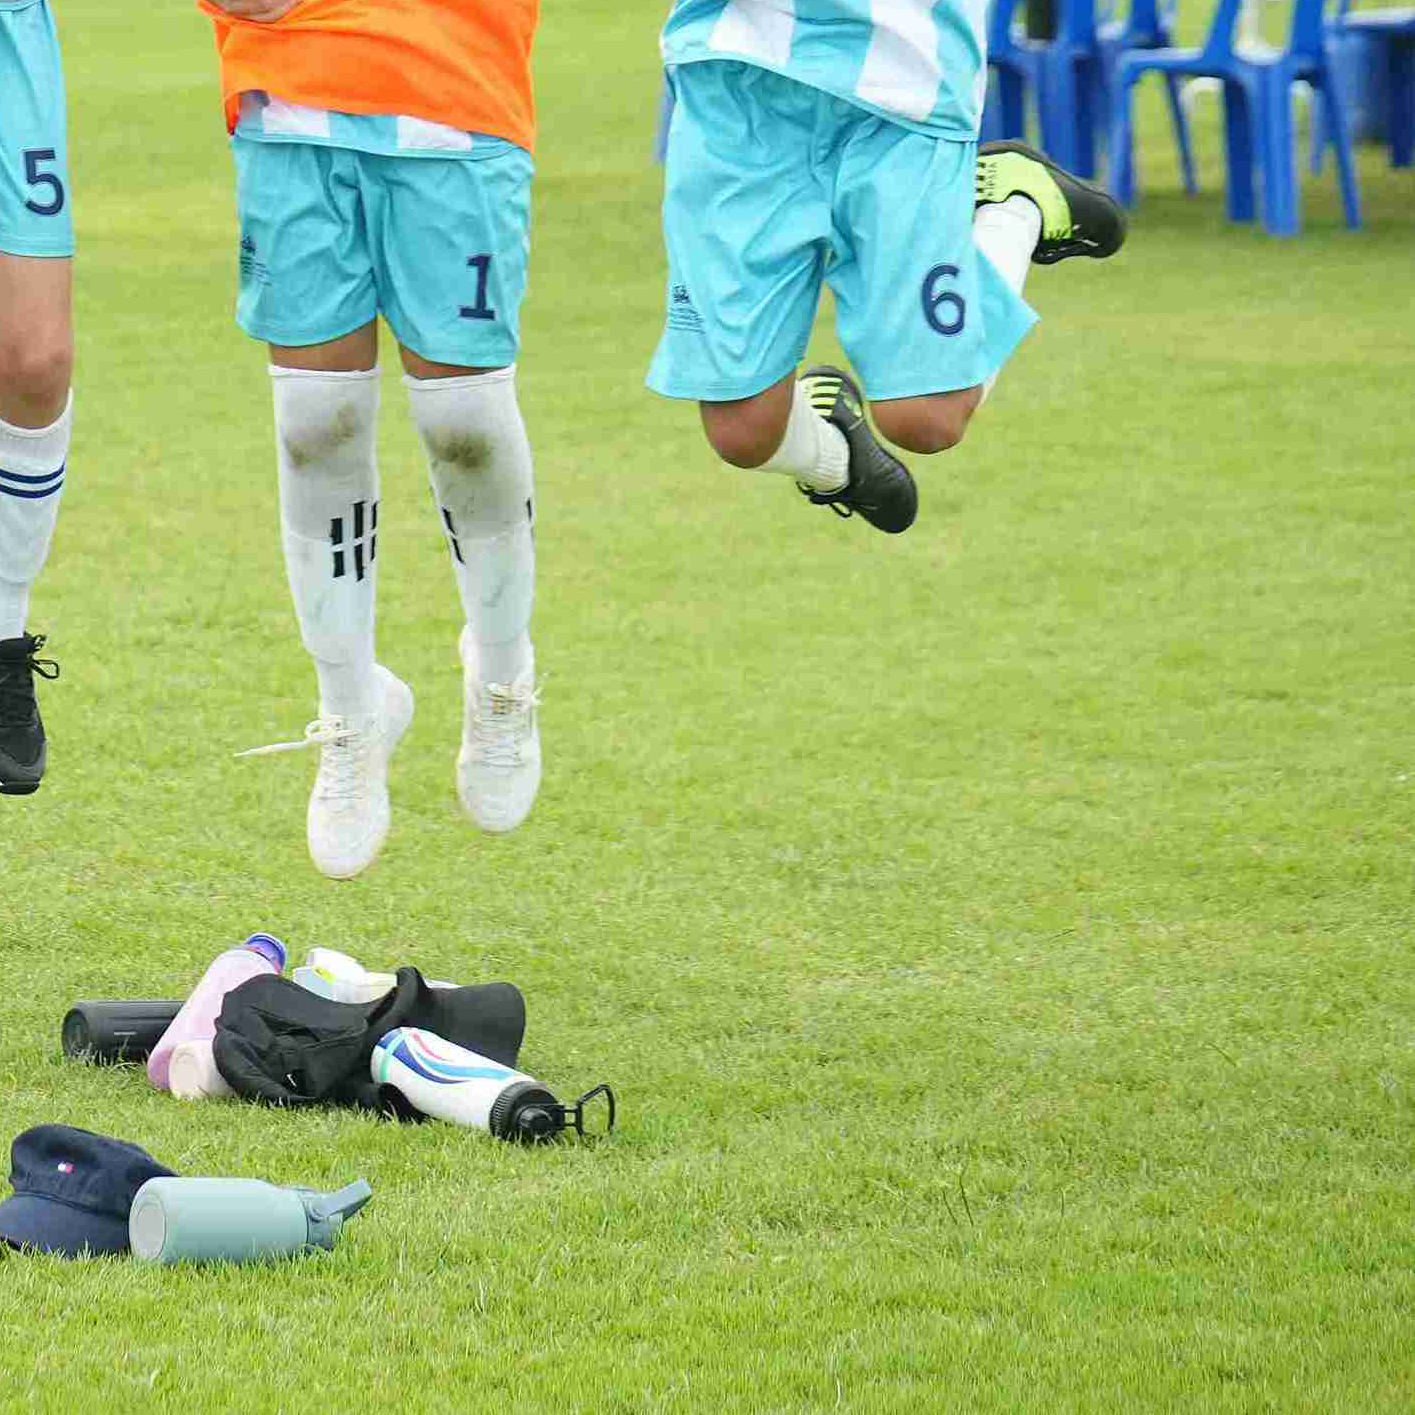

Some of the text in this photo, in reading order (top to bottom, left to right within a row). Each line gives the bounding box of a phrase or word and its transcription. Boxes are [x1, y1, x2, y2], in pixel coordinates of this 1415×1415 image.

[24, 150, 64, 216] 5
[460, 254, 496, 320] 1
[922, 265, 965, 335] 6
